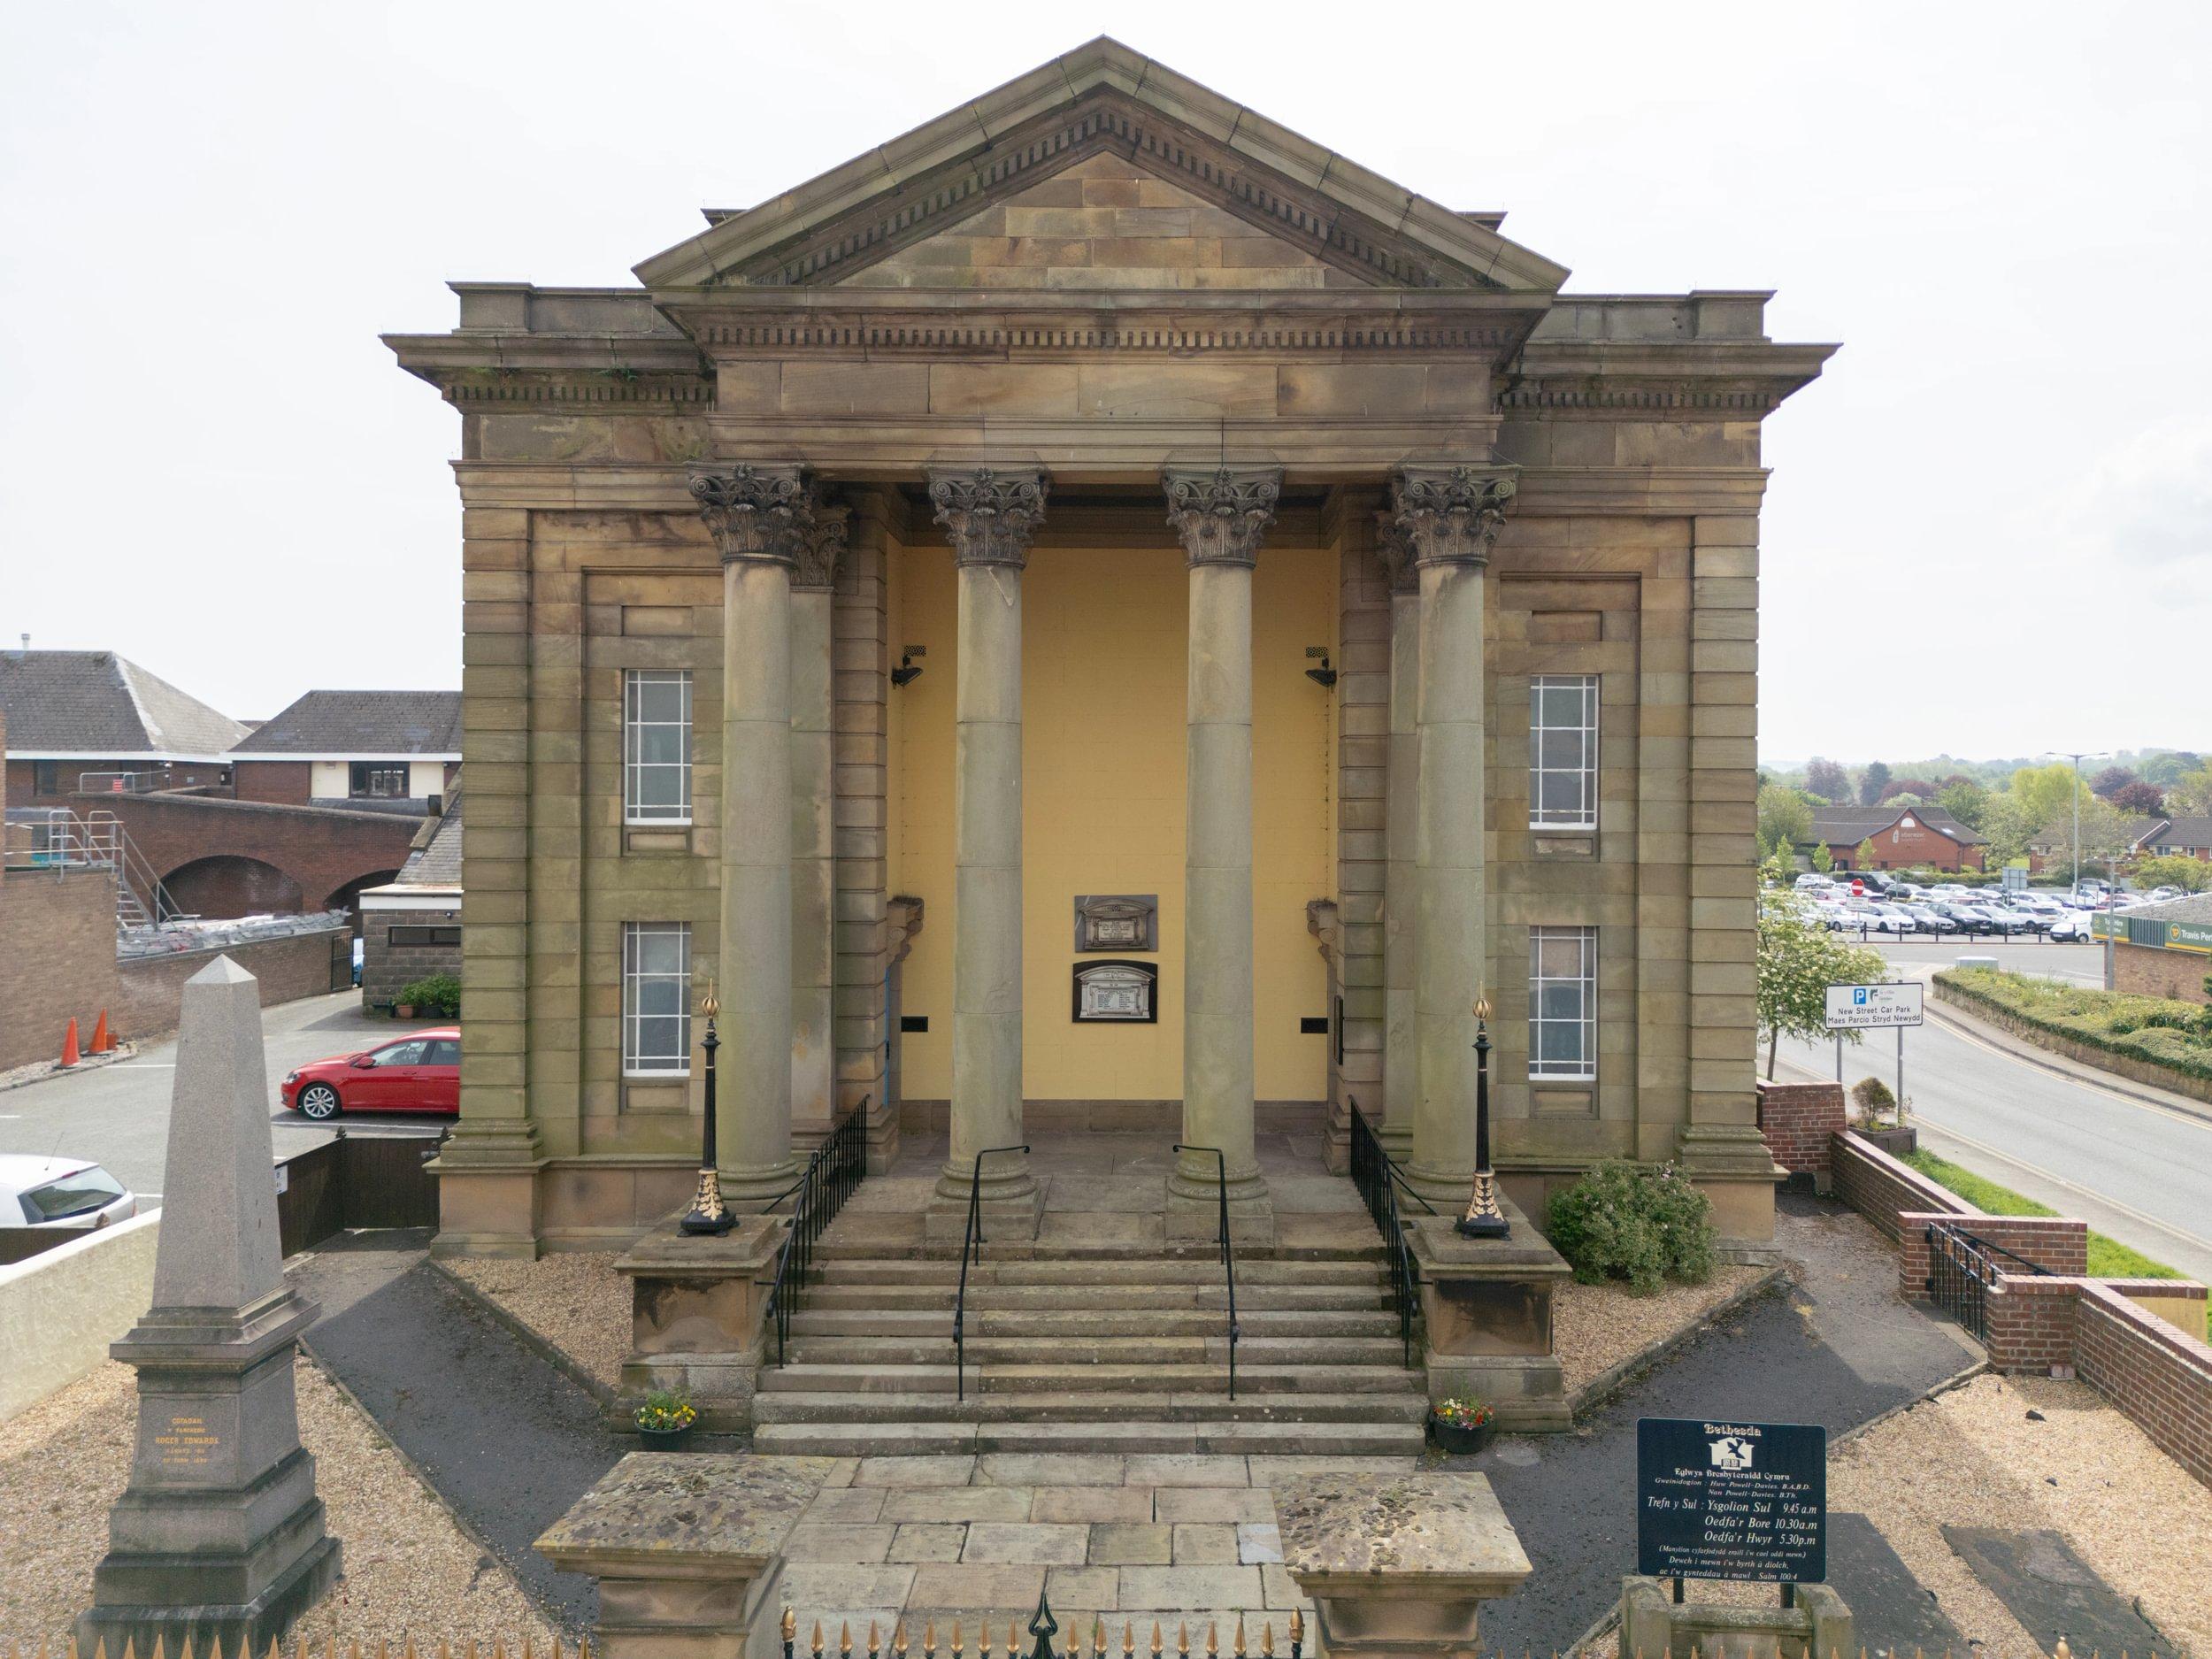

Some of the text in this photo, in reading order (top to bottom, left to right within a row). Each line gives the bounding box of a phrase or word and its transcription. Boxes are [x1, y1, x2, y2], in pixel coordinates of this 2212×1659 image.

[2181, 929, 2212, 941] Travis Per
[1856, 989, 1864, 1003] P
[1872, 1015, 1891, 1024] Stryd
[1893, 1014, 1920, 1023] Newydd
[1704, 1424, 1762, 1437] Bethesda
[1674, 1468, 1790, 1481] Eglwys Bresbyteraidd Cymru
[1647, 1496, 1671, 1509] Trefn
[1672, 1501, 1679, 1510] y
[1682, 1498, 1697, 1509] Sul
[1708, 1500, 1748, 1513] Ysgolion
[1753, 1502, 1771, 1513] Sul
[1704, 1515, 1744, 1528] Oedfa'r
[1748, 1517, 1771, 1528] Bore
[1704, 1531, 1743, 1544] Oedfa'r
[1747, 1532, 1773, 1546] Hwyr
[1658, 1544, 1690, 1554] (Manylion
[1691, 1547, 1726, 1555] cyfarfodydd
[1669, 1555, 1693, 1564] Dewch
[1683, 1569, 1721, 1578] gynteddau
